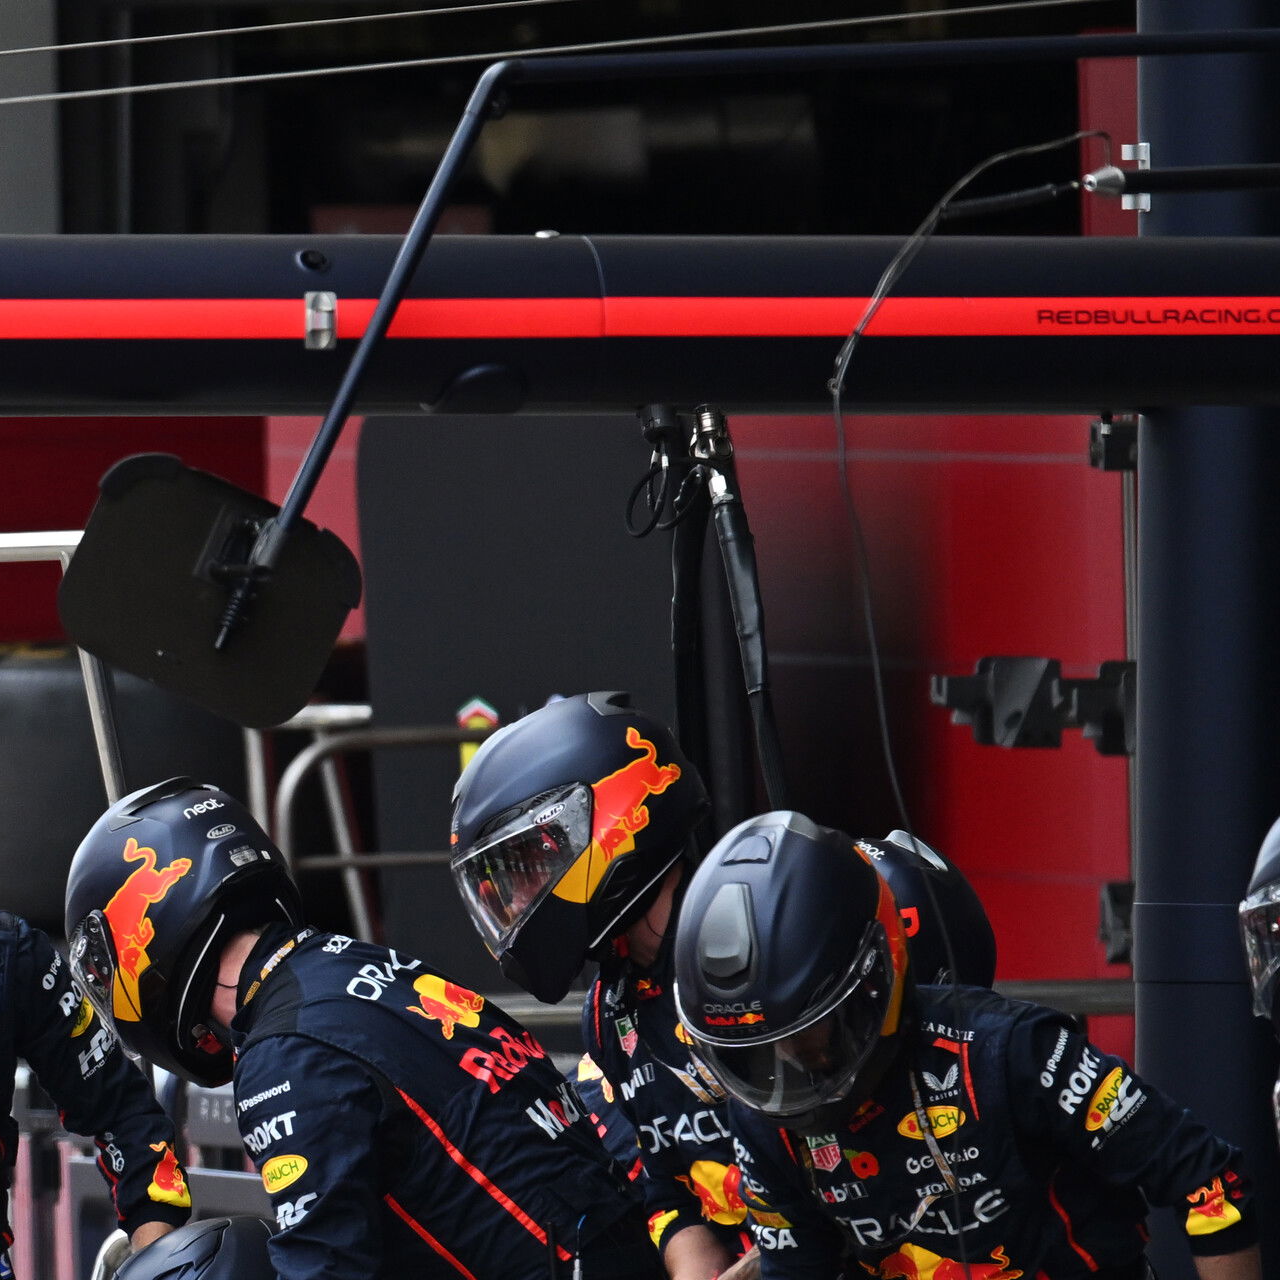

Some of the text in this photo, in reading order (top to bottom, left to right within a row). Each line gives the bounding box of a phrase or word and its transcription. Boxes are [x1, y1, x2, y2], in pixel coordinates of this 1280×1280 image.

[183, 798, 225, 819] neat.
[59, 980, 83, 1017] RO
[704, 1000, 762, 1013] ORACLE
[1096, 1072, 1124, 1115] RAUC
[243, 1111, 297, 1155] ROKT
